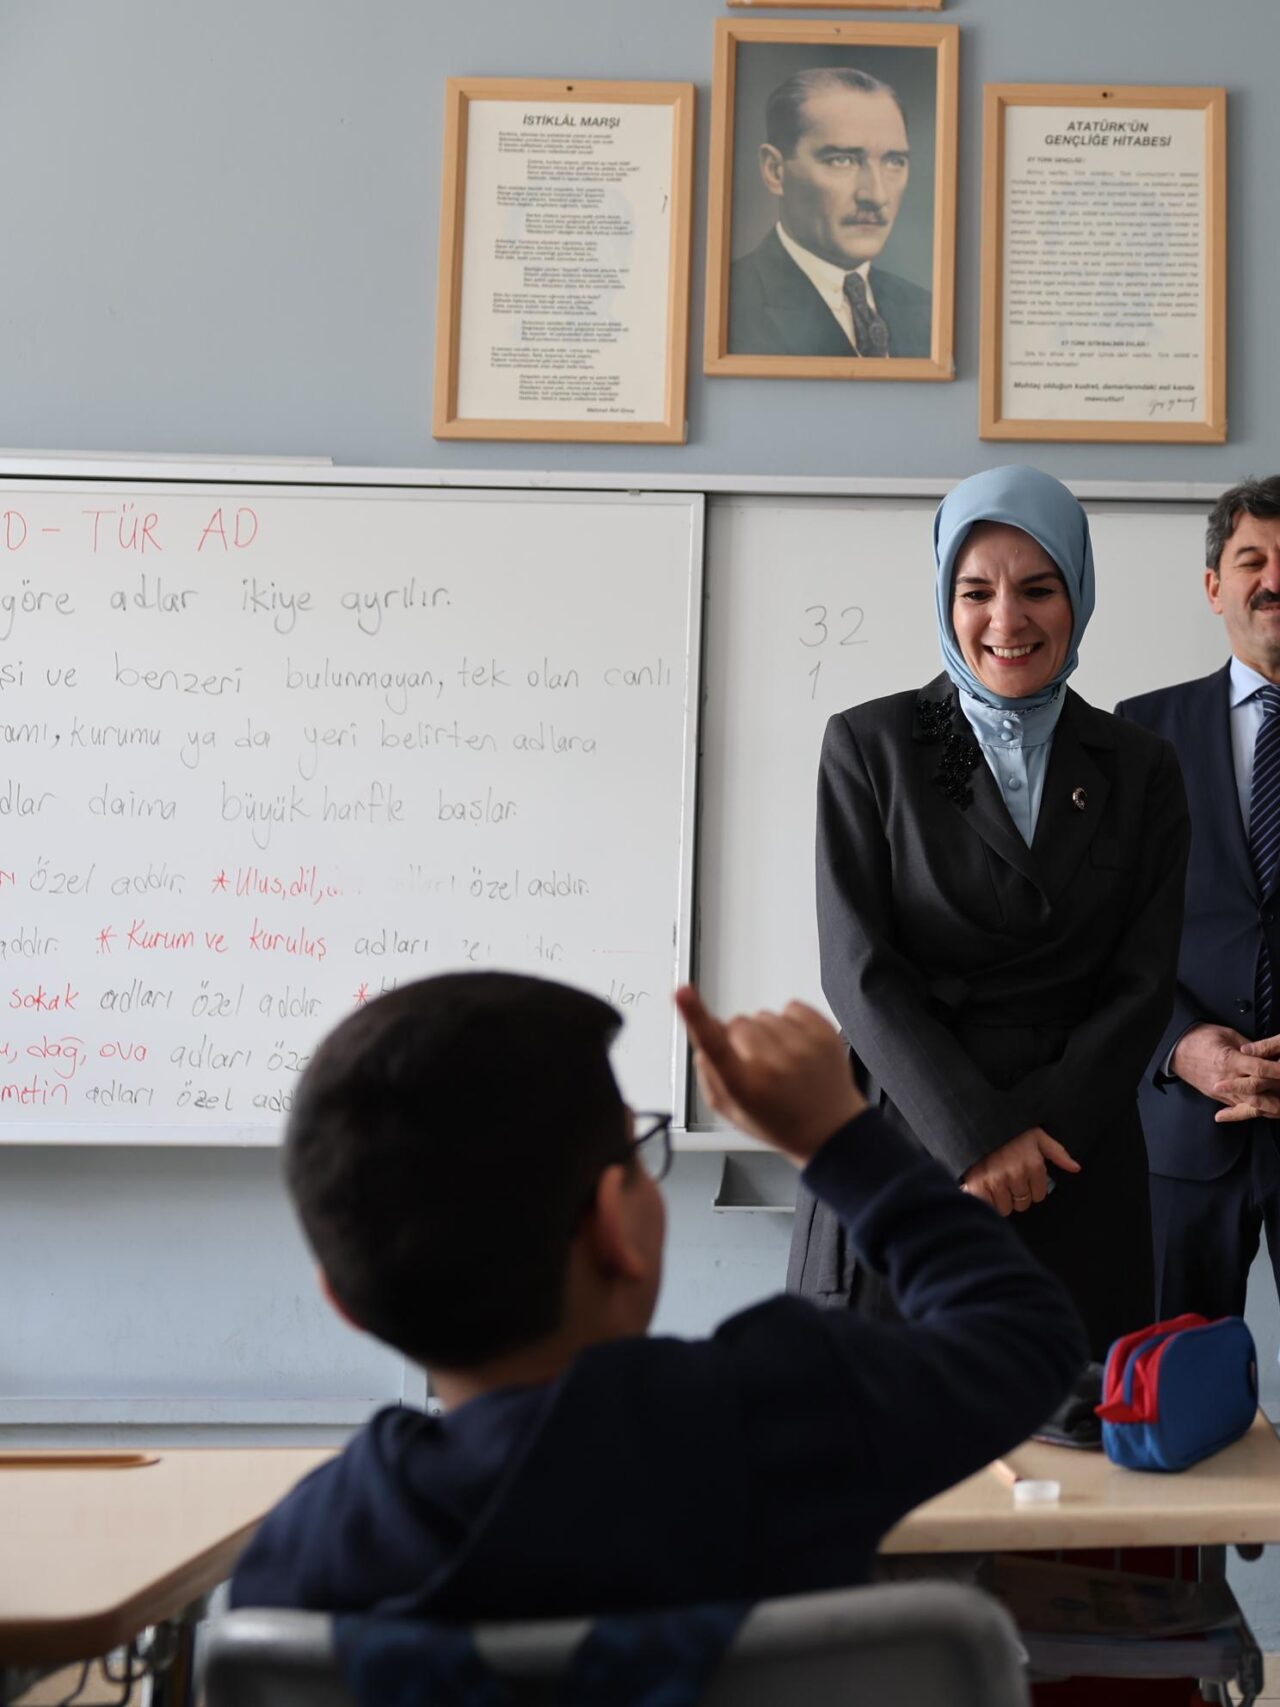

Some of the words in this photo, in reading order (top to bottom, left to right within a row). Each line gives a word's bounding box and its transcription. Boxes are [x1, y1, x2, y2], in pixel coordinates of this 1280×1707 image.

[580, 116, 621, 129] MARŞI
[1045, 133, 1109, 148] GENÇLİĞE
[1112, 134, 1172, 146] HİTABESİ
[1067, 118, 1149, 132] ATATÜRK'ÜN
[82, 503, 162, 553] TÜR
[198, 507, 258, 551] AD
[0, 579, 75, 640] göre
[110, 573, 199, 612] adlar
[242, 578, 313, 634] ikiye
[800, 605, 869, 647] 32
[46, 667, 77, 688] ve
[115, 651, 243, 695] benzeri
[286, 656, 443, 715] bulunmayan,
[457, 656, 511, 688] tek
[527, 656, 579, 689] olan
[604, 657, 670, 689] canlı
[808, 660, 821, 700] 1
[70, 716, 160, 748] kurumu
[180, 728, 216, 769] ya
[234, 718, 271, 749] da
[298, 722, 357, 781] yeri
[381, 719, 496, 752] belirten
[513, 721, 597, 753] adlara
[89, 783, 176, 816] daima
[221, 780, 311, 850] büyük
[323, 780, 404, 823] harfle
[29, 856, 96, 894] özel
[470, 866, 519, 900] özel
[128, 919, 195, 950] Kurum
[205, 932, 228, 953] ve
[250, 917, 327, 961] kuruluş
[354, 928, 428, 956] adları
[9, 983, 79, 1011] sokak
[100, 978, 172, 1013] adları
[192, 980, 244, 1018] özel
[99, 1040, 148, 1062] ova
[170, 1034, 252, 1070] adları
[0, 1074, 69, 1106] metin
[85, 1079, 154, 1107] adları
[176, 1079, 233, 1112] özel
